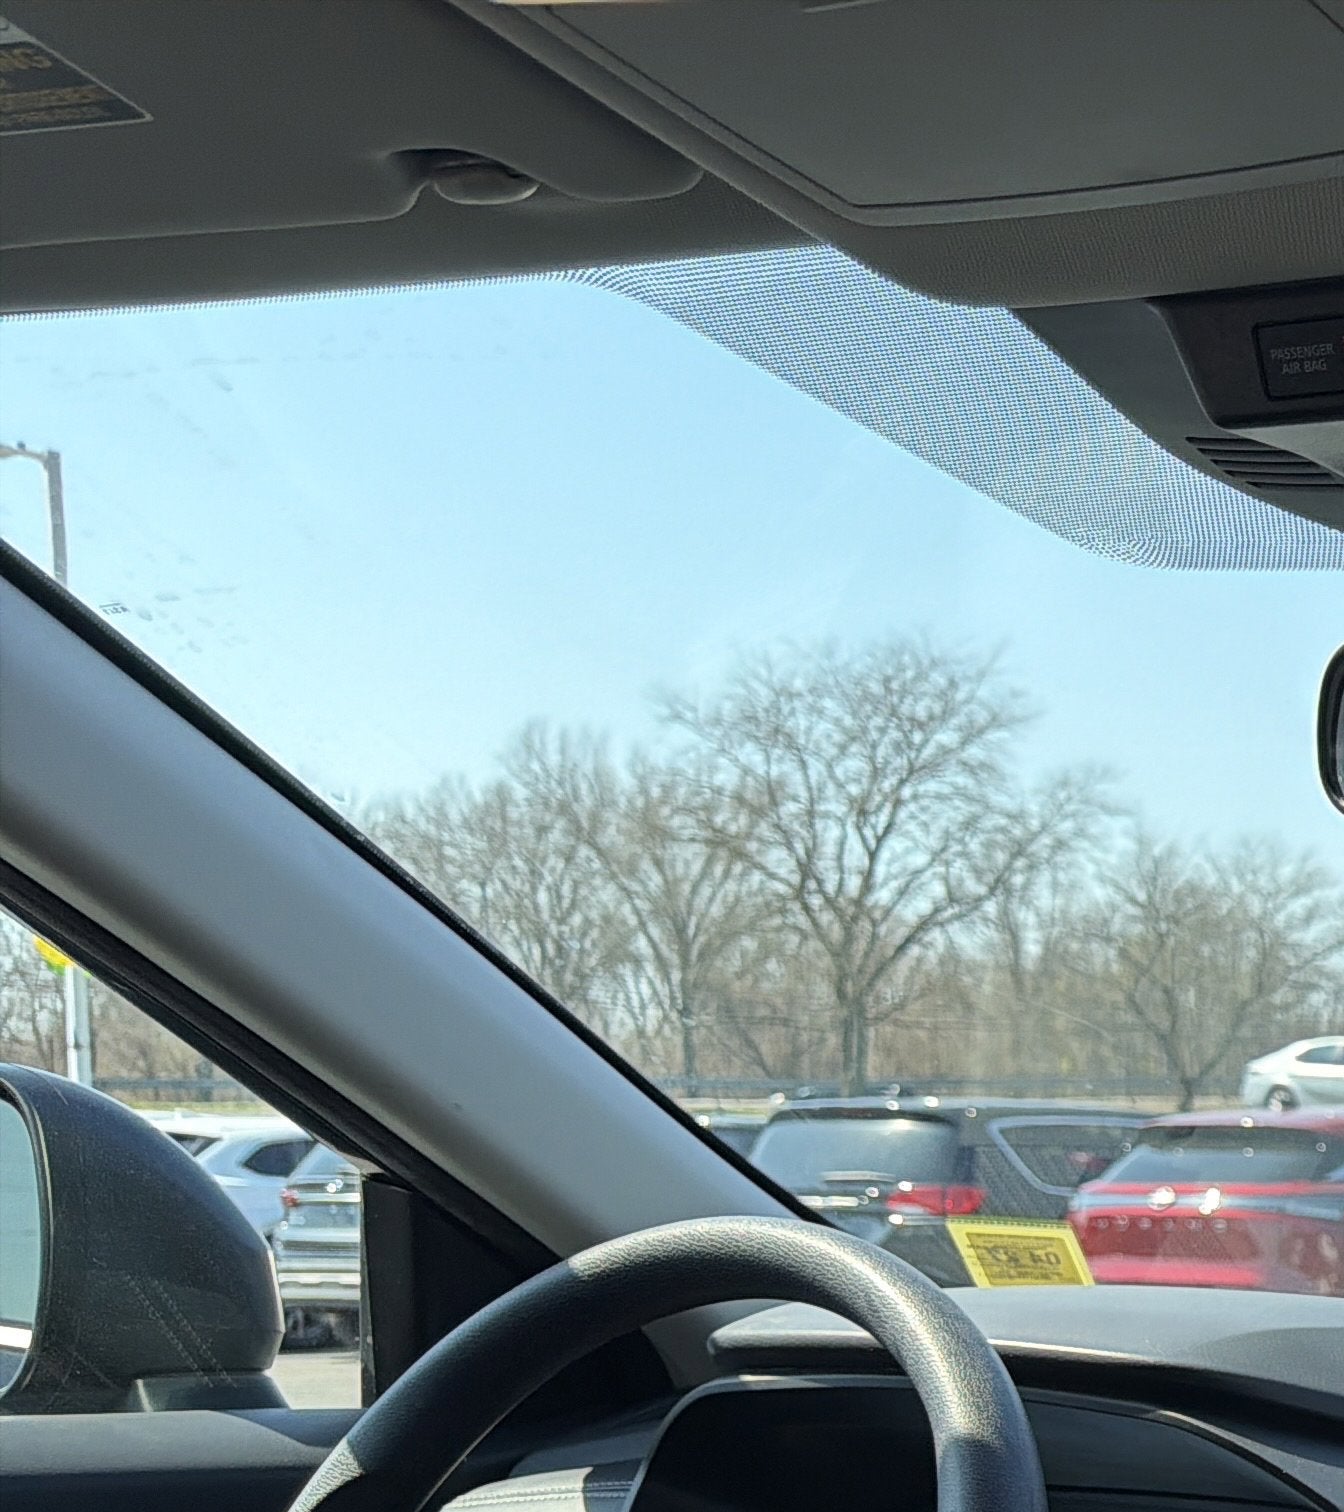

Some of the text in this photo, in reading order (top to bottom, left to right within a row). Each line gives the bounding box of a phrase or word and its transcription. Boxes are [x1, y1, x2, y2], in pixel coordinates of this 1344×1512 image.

[1270, 343, 1335, 360] PASSENGER
[1282, 360, 1327, 375] AIR BAG
